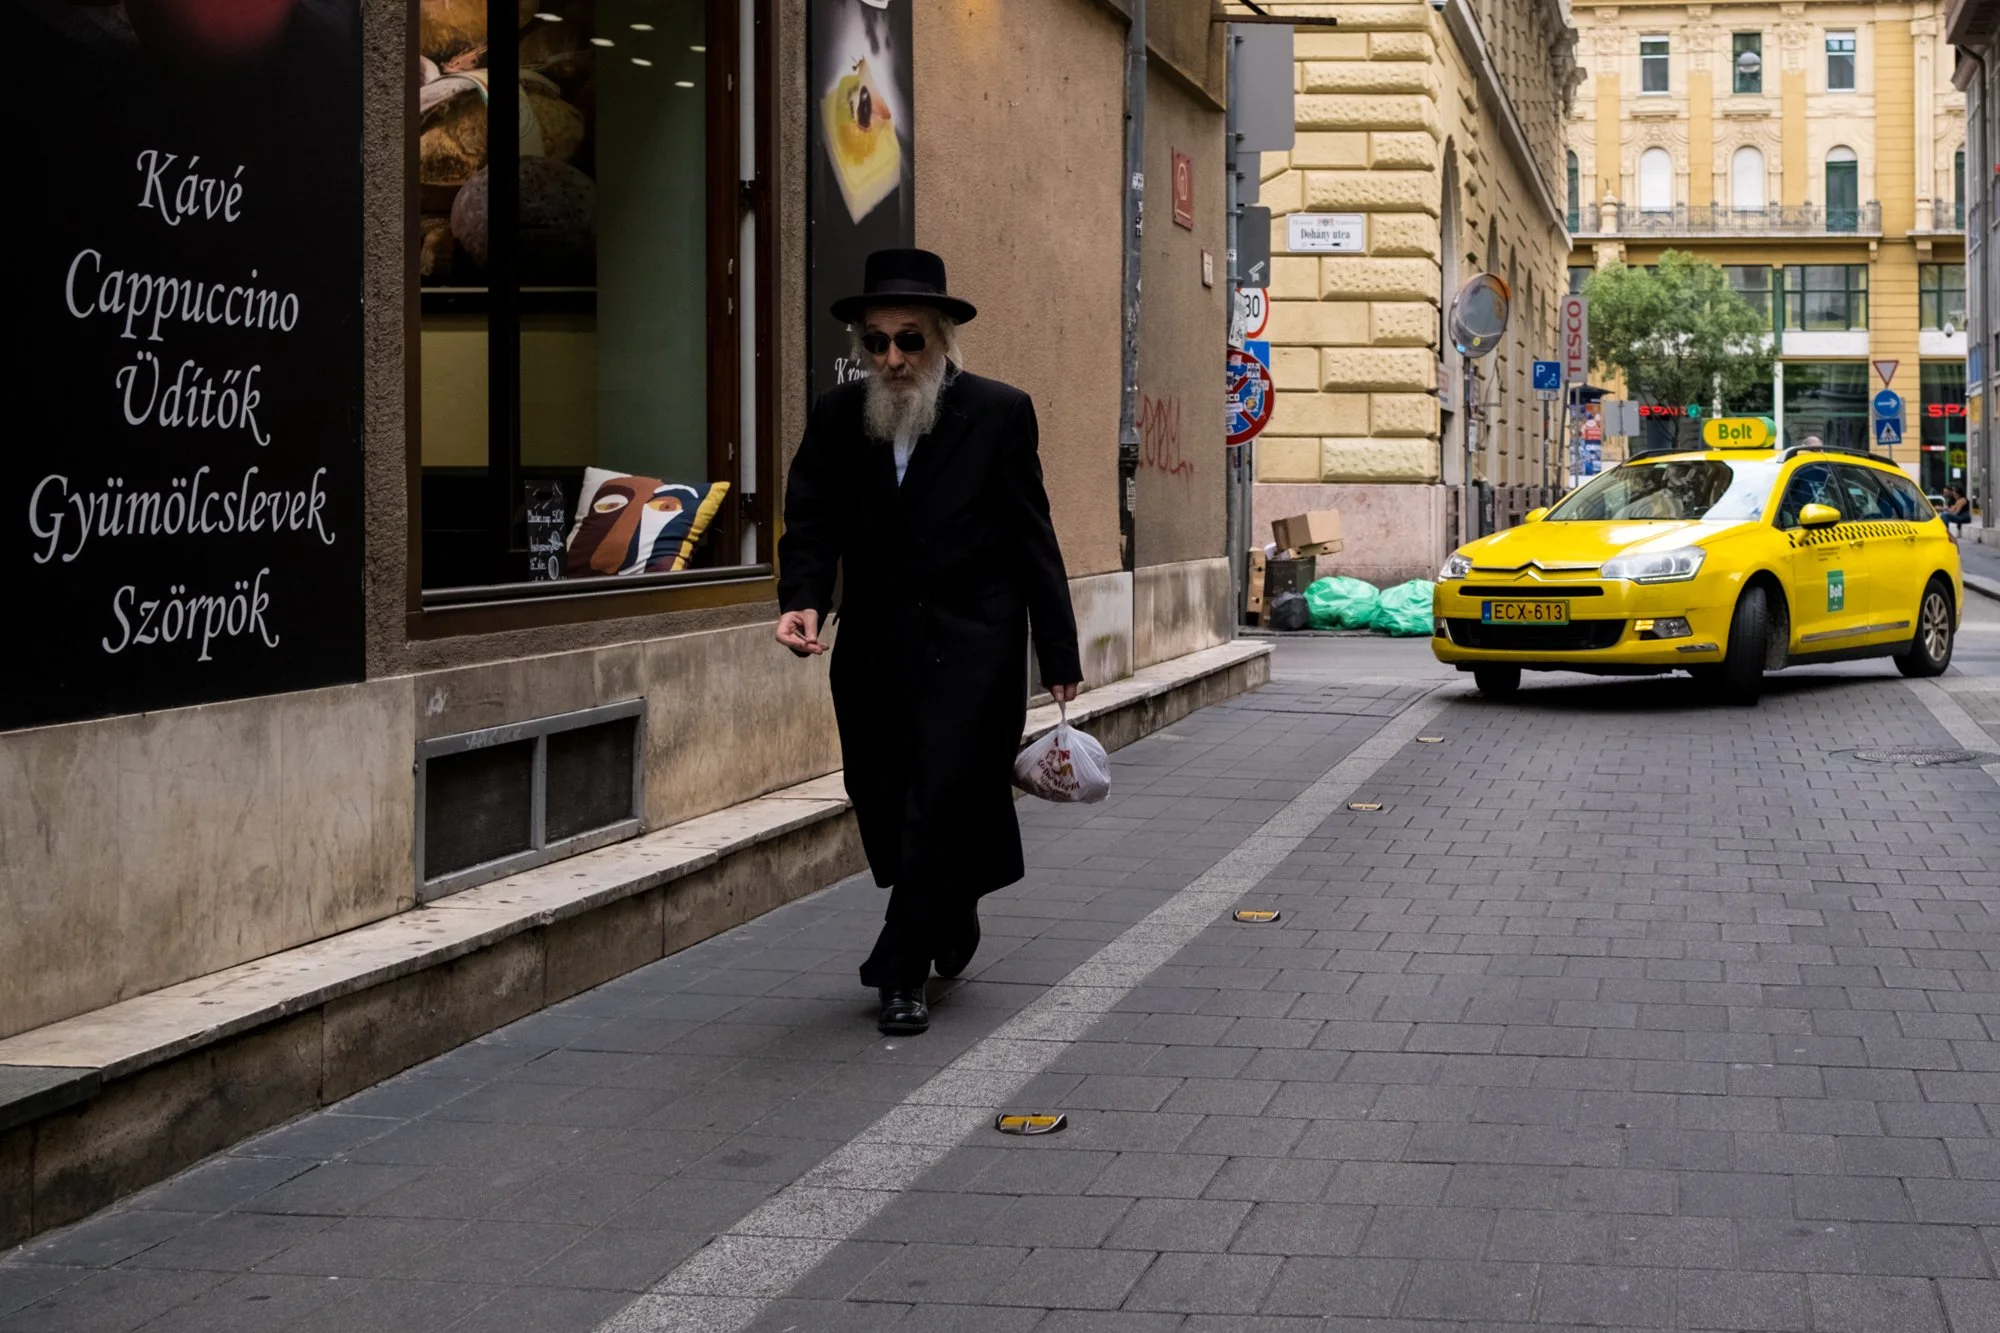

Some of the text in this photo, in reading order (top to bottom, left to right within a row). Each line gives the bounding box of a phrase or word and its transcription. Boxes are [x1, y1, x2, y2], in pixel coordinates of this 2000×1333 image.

[136, 149, 245, 226] Kávé
[65, 248, 299, 342] Cappuccino
[1245, 294, 1260, 318] 30
[1567, 300, 1582, 378] TESCO
[1536, 364, 1546, 378] P
[115, 350, 271, 447] Üdítők
[1928, 403, 1967, 417] SPA
[1718, 423, 1752, 440] Bolt
[29, 465, 336, 565] Gyümölcslevek
[102, 567, 280, 662] Szörpök
[1494, 604, 1562, 620] ECX-613
[1829, 584, 1843, 598] Bolt
